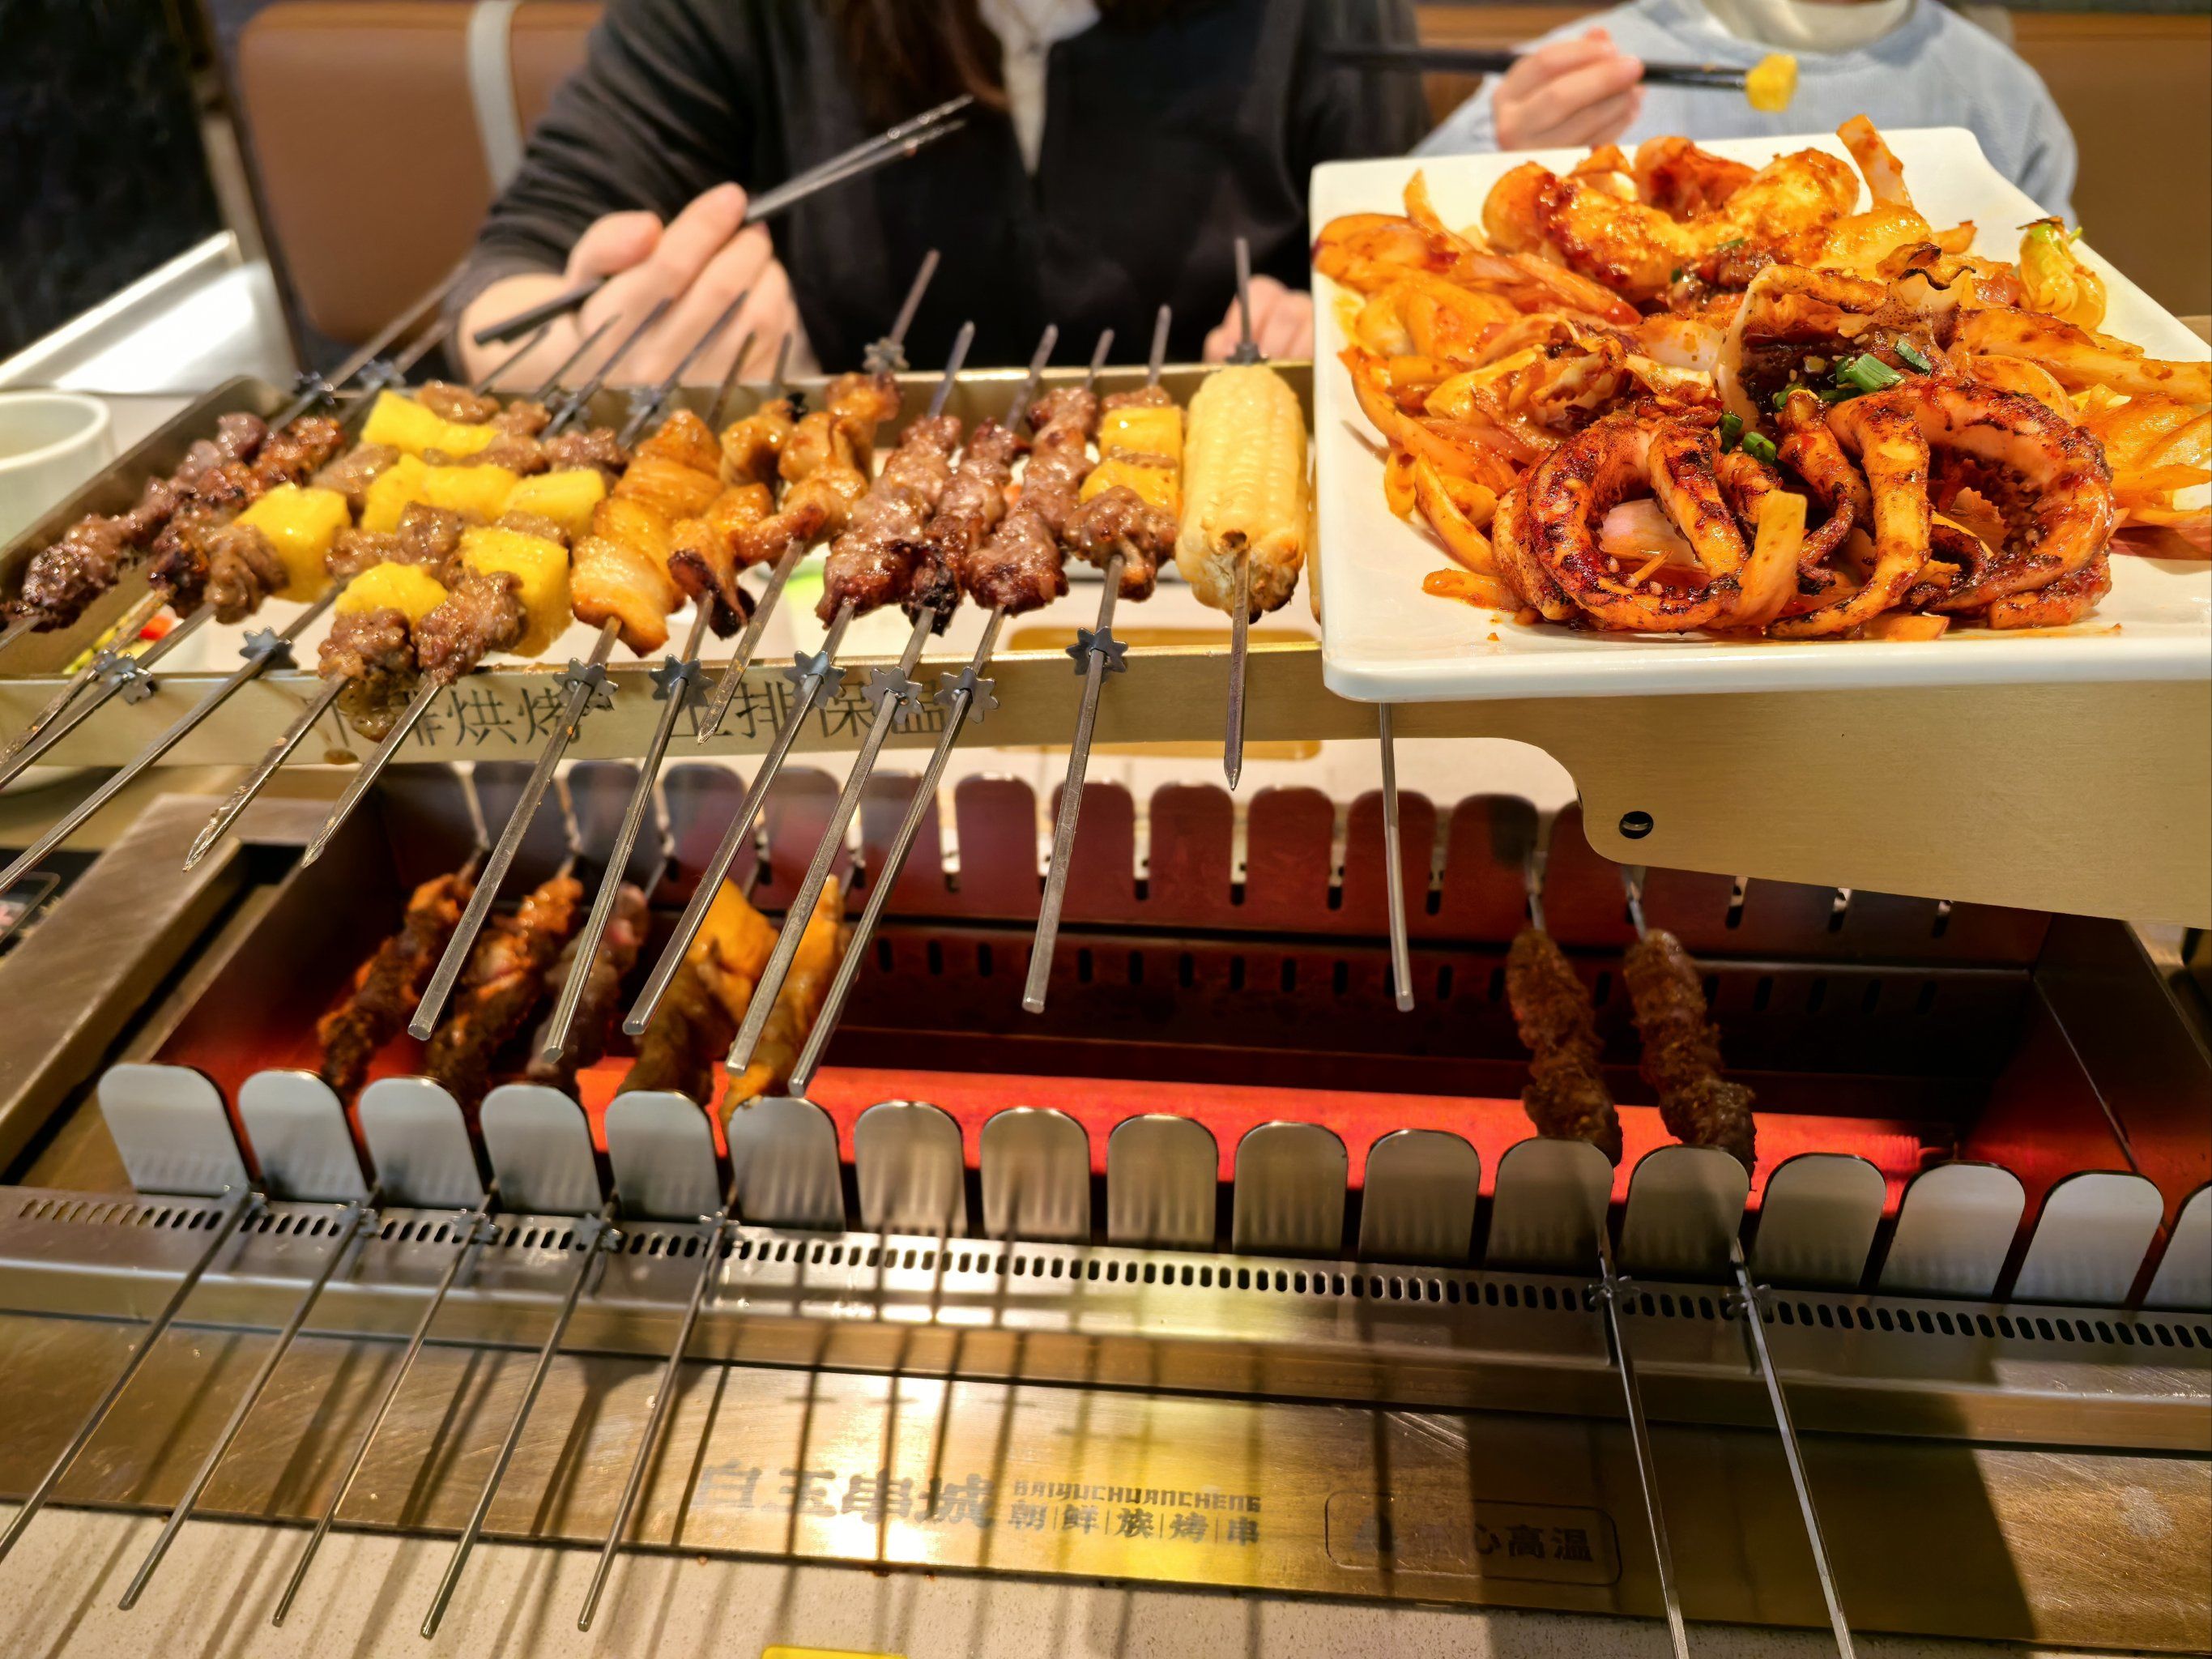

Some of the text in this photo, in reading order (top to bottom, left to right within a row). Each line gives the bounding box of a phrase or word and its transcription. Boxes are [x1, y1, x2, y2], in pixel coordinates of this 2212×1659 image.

[306, 685, 583, 747] 烘烤
[691, 1460, 995, 1528] 白玉串城
[1417, 1521, 1594, 1563] 心高温
